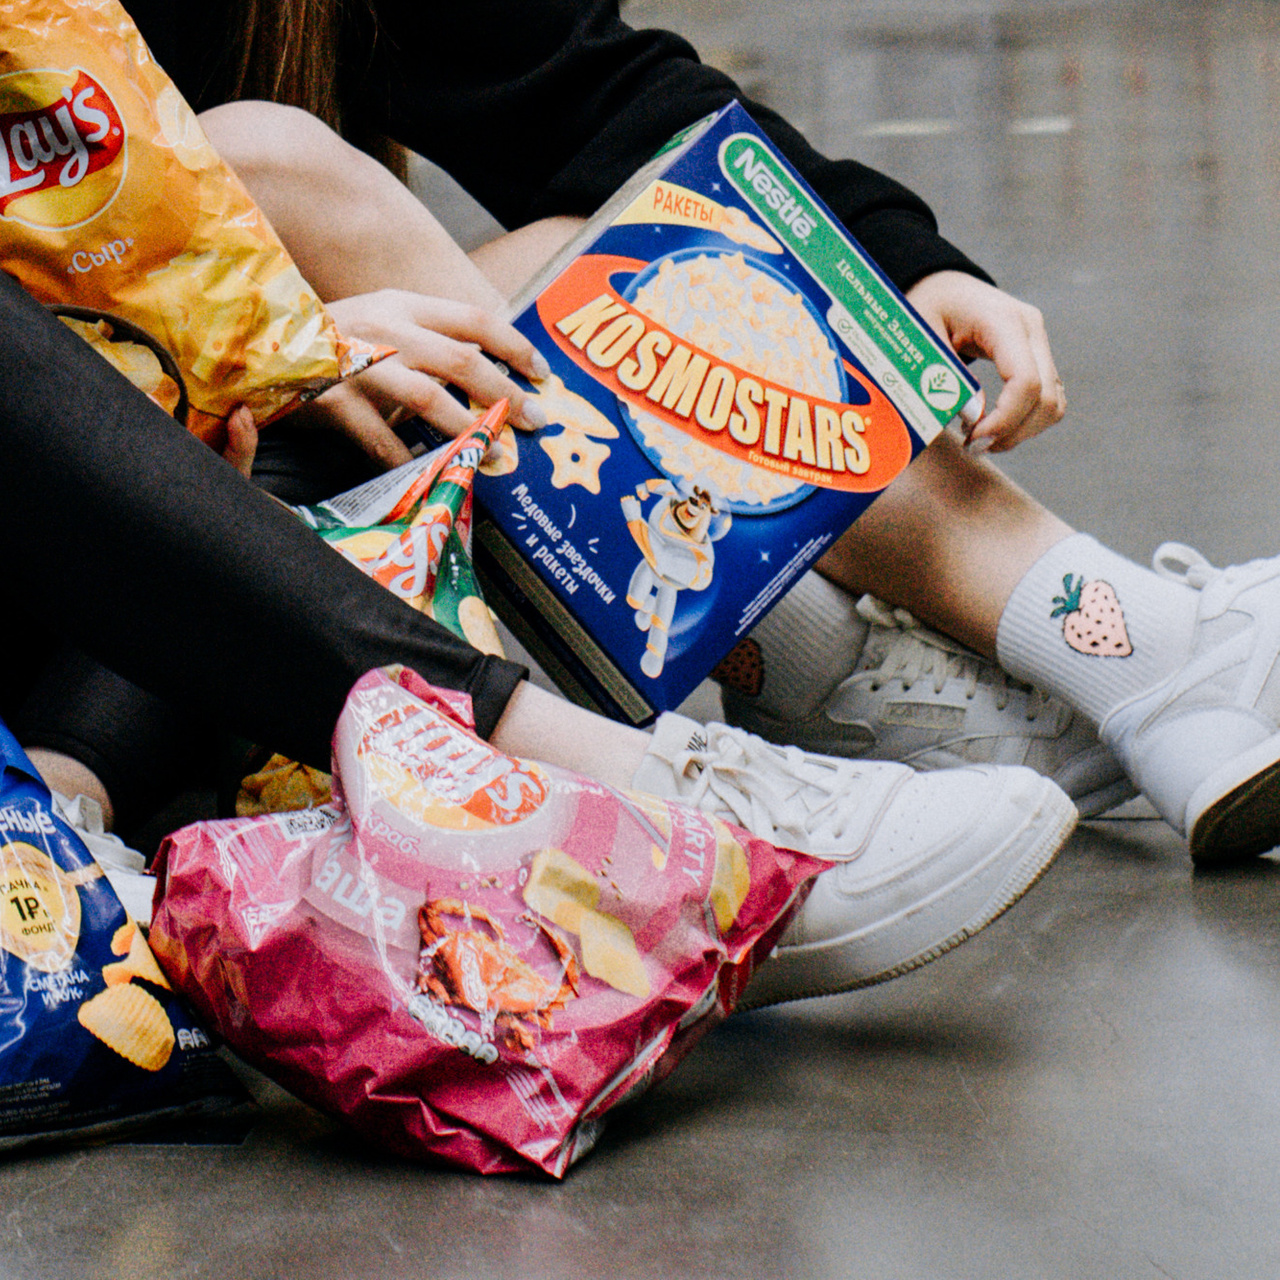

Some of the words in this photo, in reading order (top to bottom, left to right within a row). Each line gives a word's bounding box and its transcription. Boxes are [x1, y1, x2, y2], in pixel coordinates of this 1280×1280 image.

[653, 186, 715, 225] РАКЕТЫ
[836, 258, 890, 322] Цельные
[887, 318, 925, 362] Злаки
[554, 292, 871, 475] KOSMOSTARS
[748, 450, 790, 472] Готовый
[792, 465, 833, 485] завтрак
[511, 483, 563, 543] Медовые
[555, 539, 617, 605] звездочки
[525, 532, 539, 548] и
[532, 544, 580, 596] ракеты
